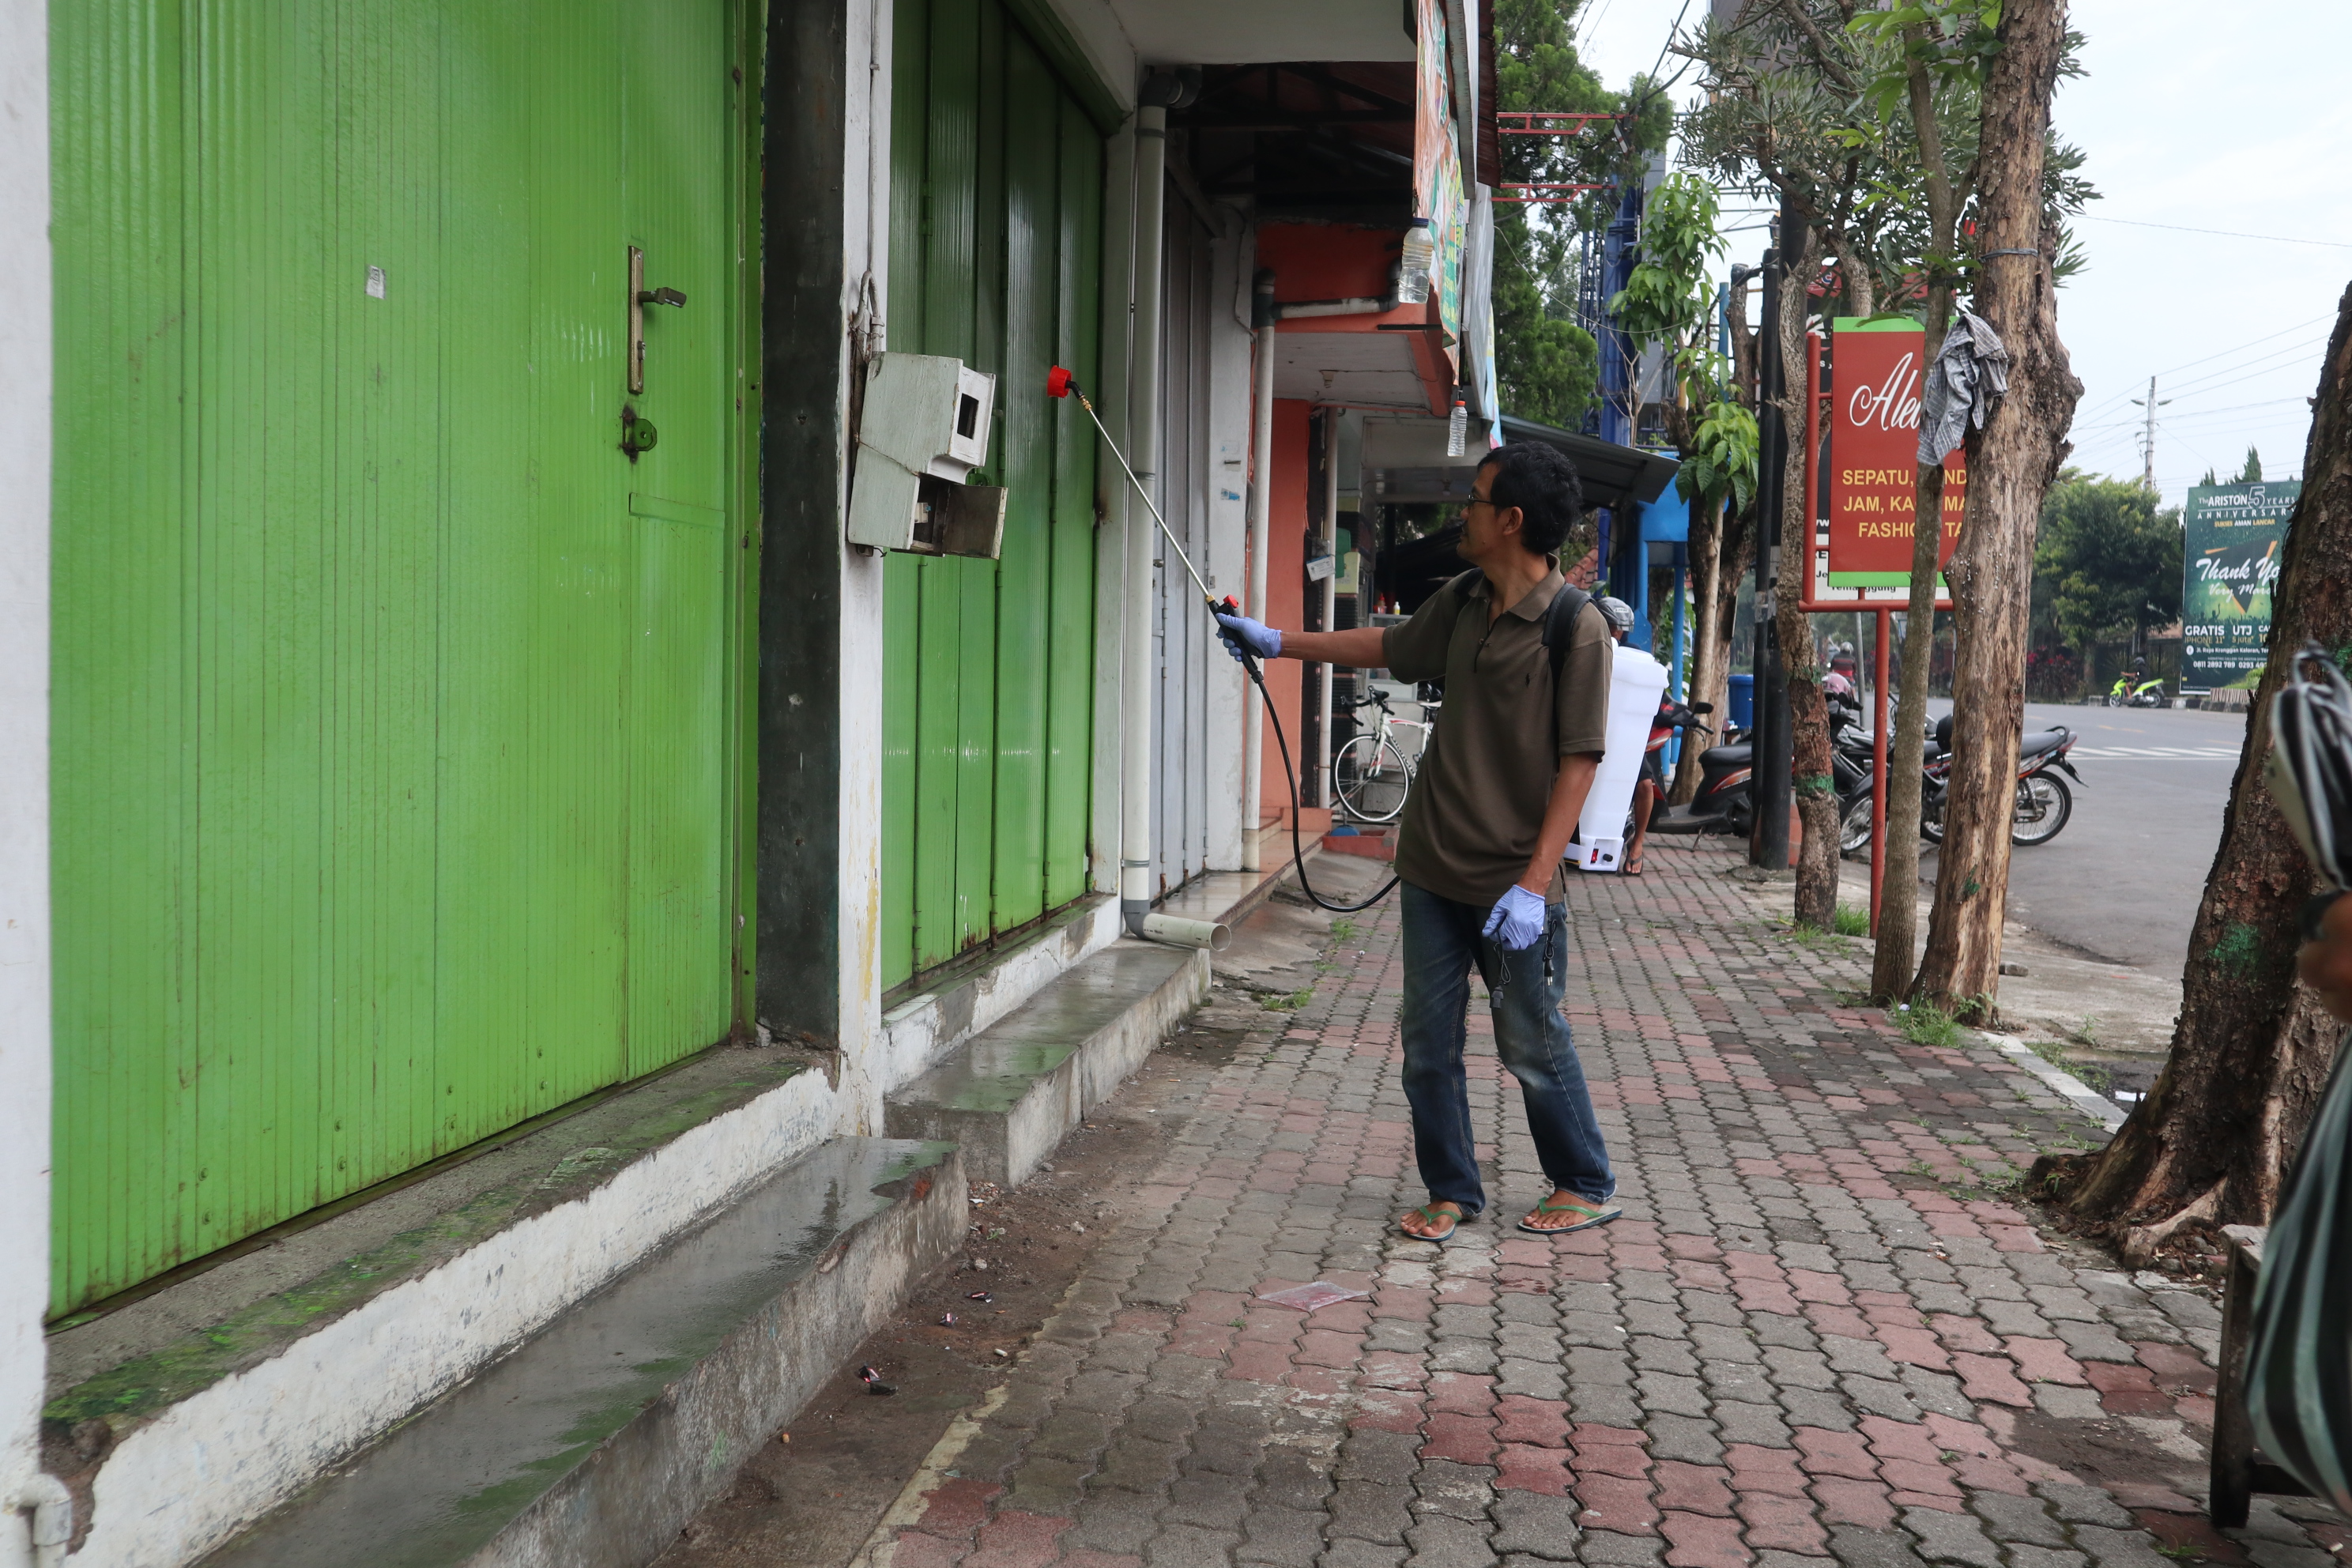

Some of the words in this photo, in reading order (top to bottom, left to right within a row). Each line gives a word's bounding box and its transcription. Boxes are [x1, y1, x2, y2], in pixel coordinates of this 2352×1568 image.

[1842, 469, 1914, 488] SEPATU,
[1843, 496, 1884, 514] JAM,
[1890, 496, 1916, 511] KA
[2208, 493, 2248, 507] ARISTON
[2248, 485, 2266, 510] 5
[2267, 496, 2295, 505] YEARS
[1859, 522, 1915, 537] FASHI
[2196, 557, 2251, 582] Thank
[2256, 556, 2280, 586] Yo
[2209, 582, 2233, 603] Very
[2184, 624, 2225, 636] GRATIS
[2232, 624, 2252, 636] UTJ
